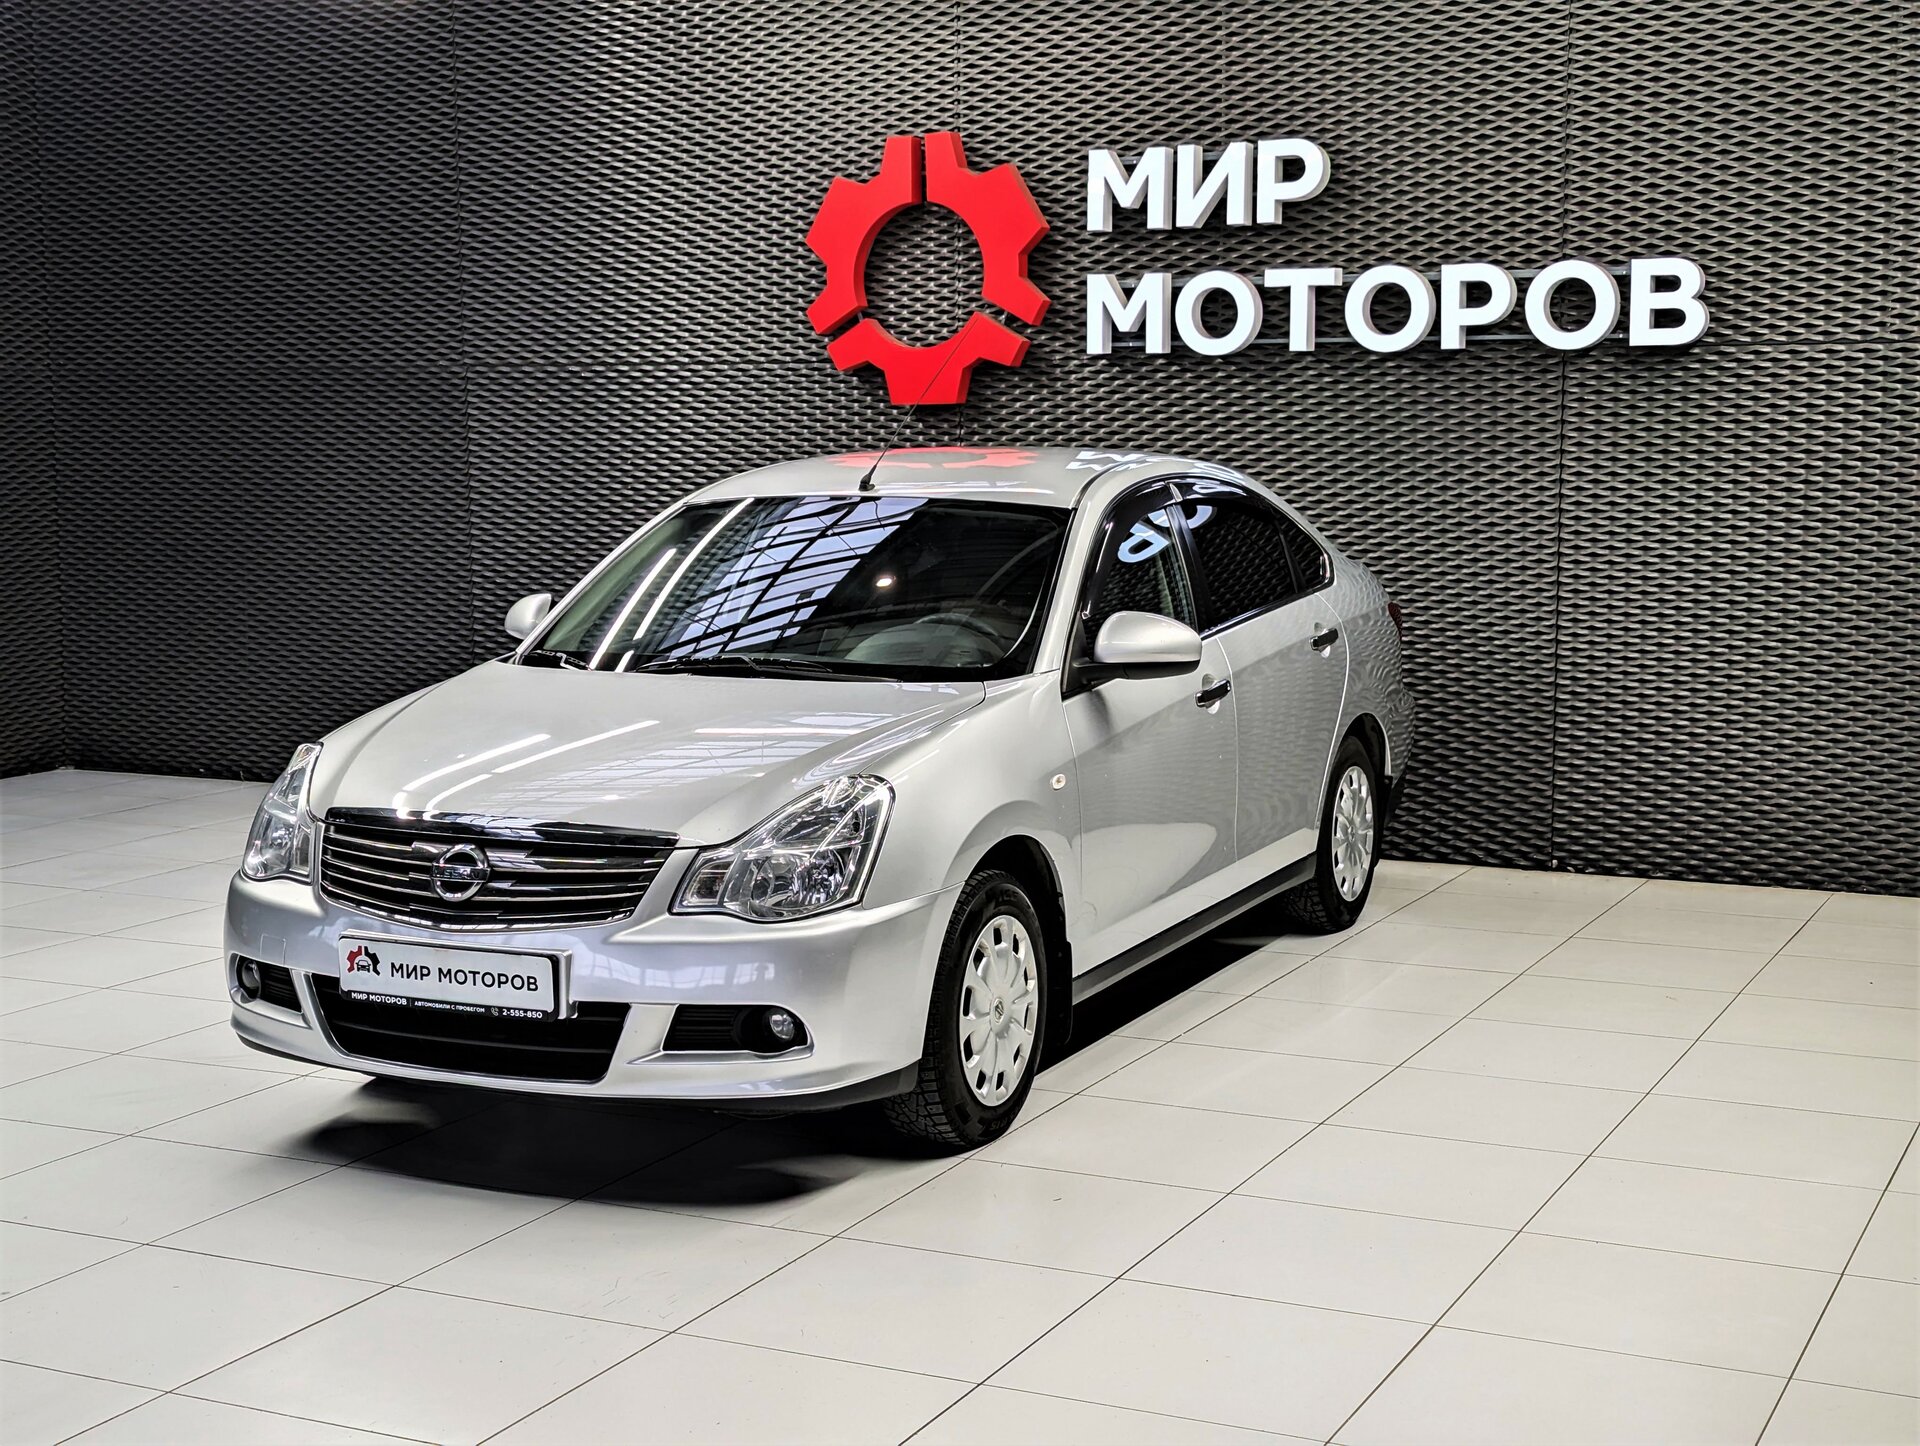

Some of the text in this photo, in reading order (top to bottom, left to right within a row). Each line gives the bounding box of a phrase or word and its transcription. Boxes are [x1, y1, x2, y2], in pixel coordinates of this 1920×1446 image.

[1086, 137, 1331, 233] МИР
[1086, 257, 1710, 356] МОТОРОВ
[390, 962, 539, 992] МИР МОТОРОВ
[351, 992, 408, 1006] МИР МОТОРОВ
[414, 1001, 450, 1009] АВТОМОБИЛИ
[456, 1005, 485, 1013] ПРОБЕГОМ
[502, 1008, 543, 1019] 2-555-850
